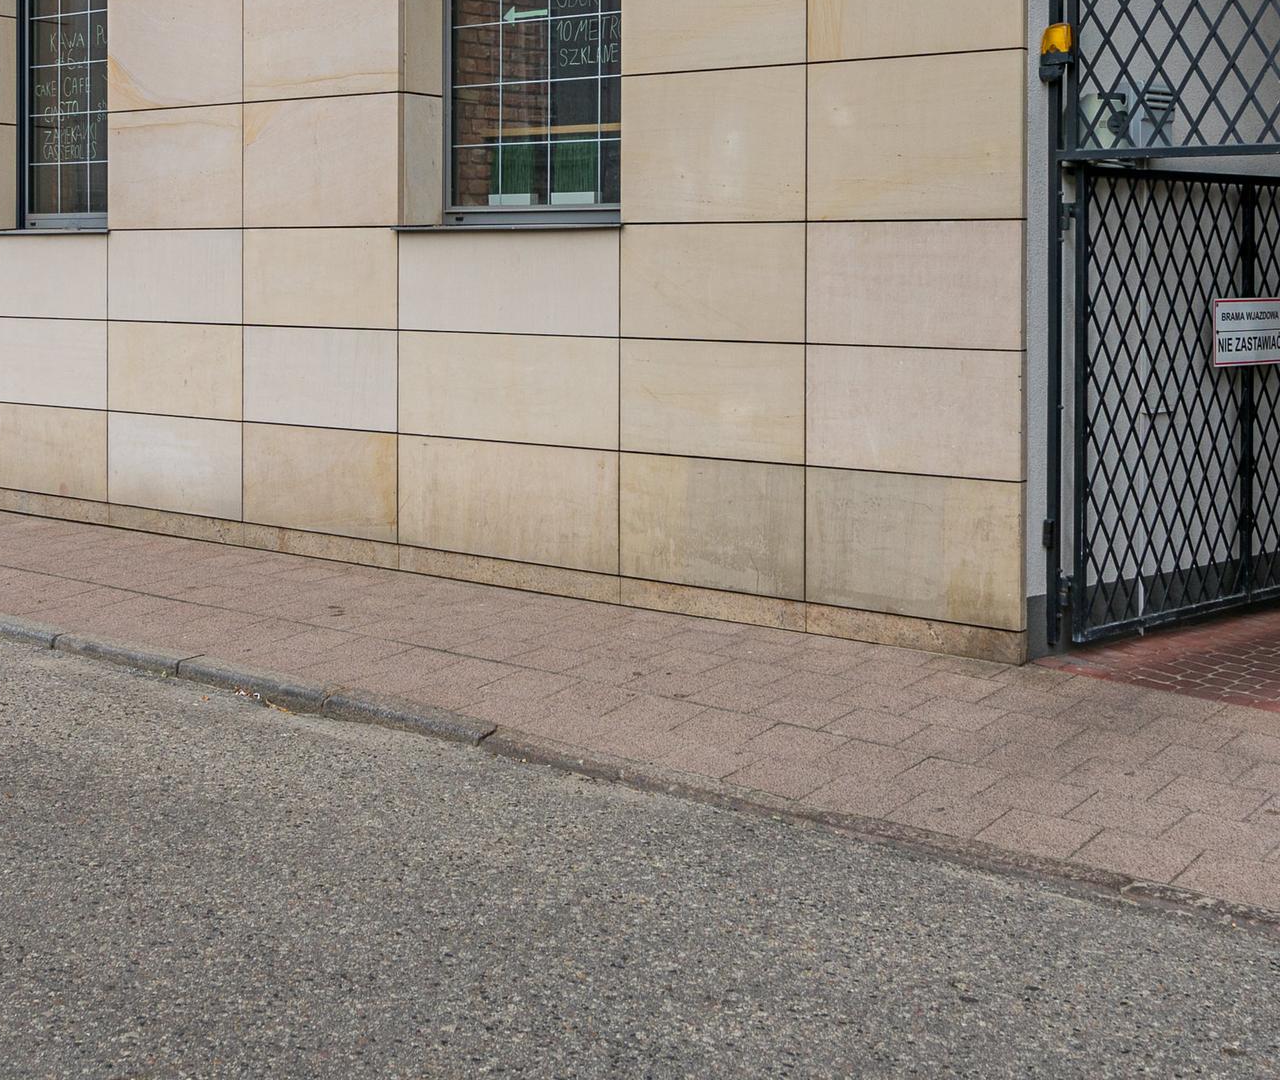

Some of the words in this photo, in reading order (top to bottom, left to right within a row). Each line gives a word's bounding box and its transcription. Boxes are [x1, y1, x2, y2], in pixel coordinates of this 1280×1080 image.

[556, 20, 572, 41] 10
[50, 32, 85, 53] KAWA
[560, 43, 619, 67] SZKLANE
[35, 80, 57, 97] CAKE
[1221, 312, 1245, 322] BRAMA
[1246, 310, 1280, 321] WJAZDOWA
[1218, 337, 1233, 353] NIE
